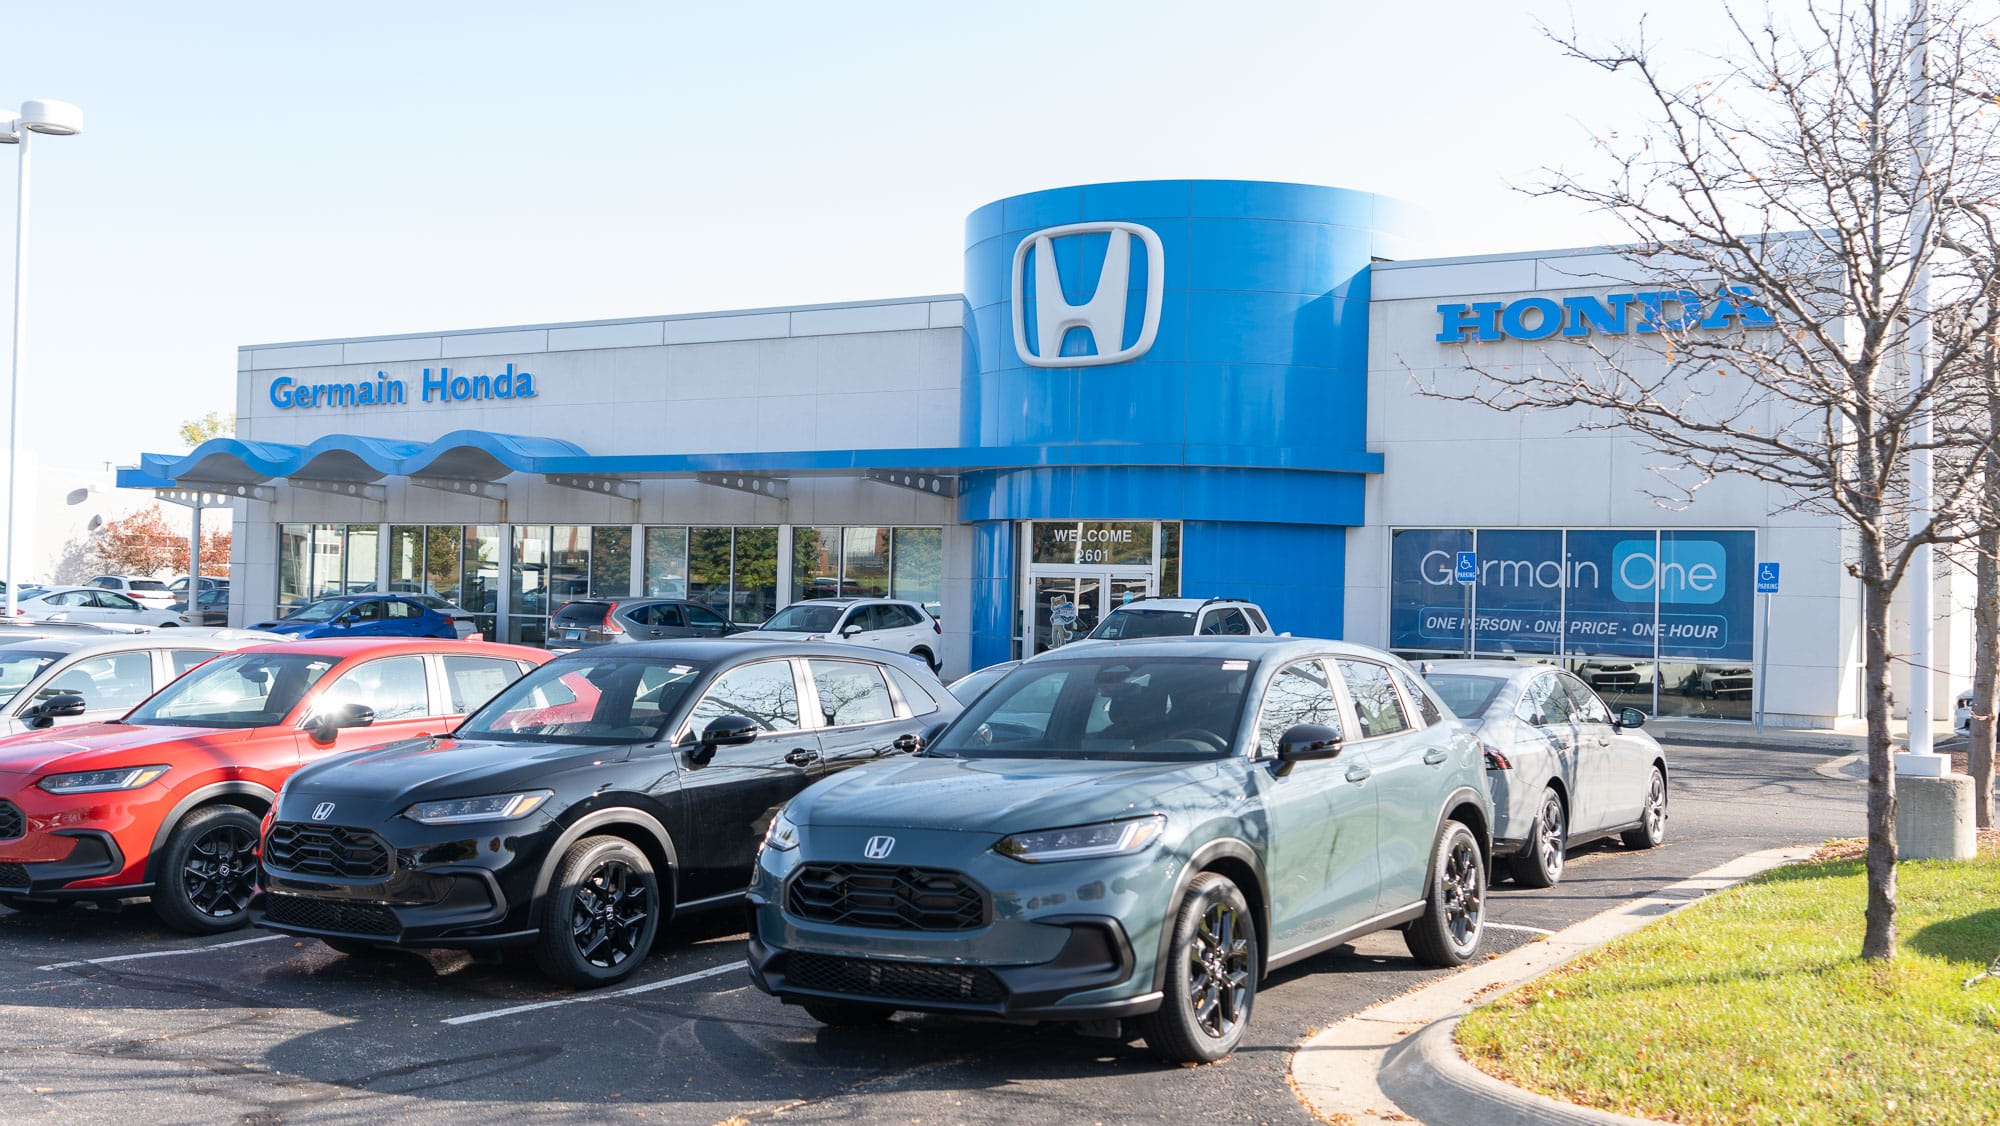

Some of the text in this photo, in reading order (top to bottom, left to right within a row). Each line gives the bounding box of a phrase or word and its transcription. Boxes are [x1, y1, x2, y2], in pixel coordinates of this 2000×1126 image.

[1436, 286, 1777, 343] HONDA
[269, 363, 536, 409] Germain Honda
[1054, 529, 1132, 542] WELCOME
[1078, 549, 1109, 562] 2601
[1420, 550, 1717, 591] Grmain One
[1426, 616, 1458, 629] ONE
[1570, 621, 1618, 636] PRICE
[1632, 623, 1667, 637] ONE
[1669, 624, 1719, 639] HOUR
